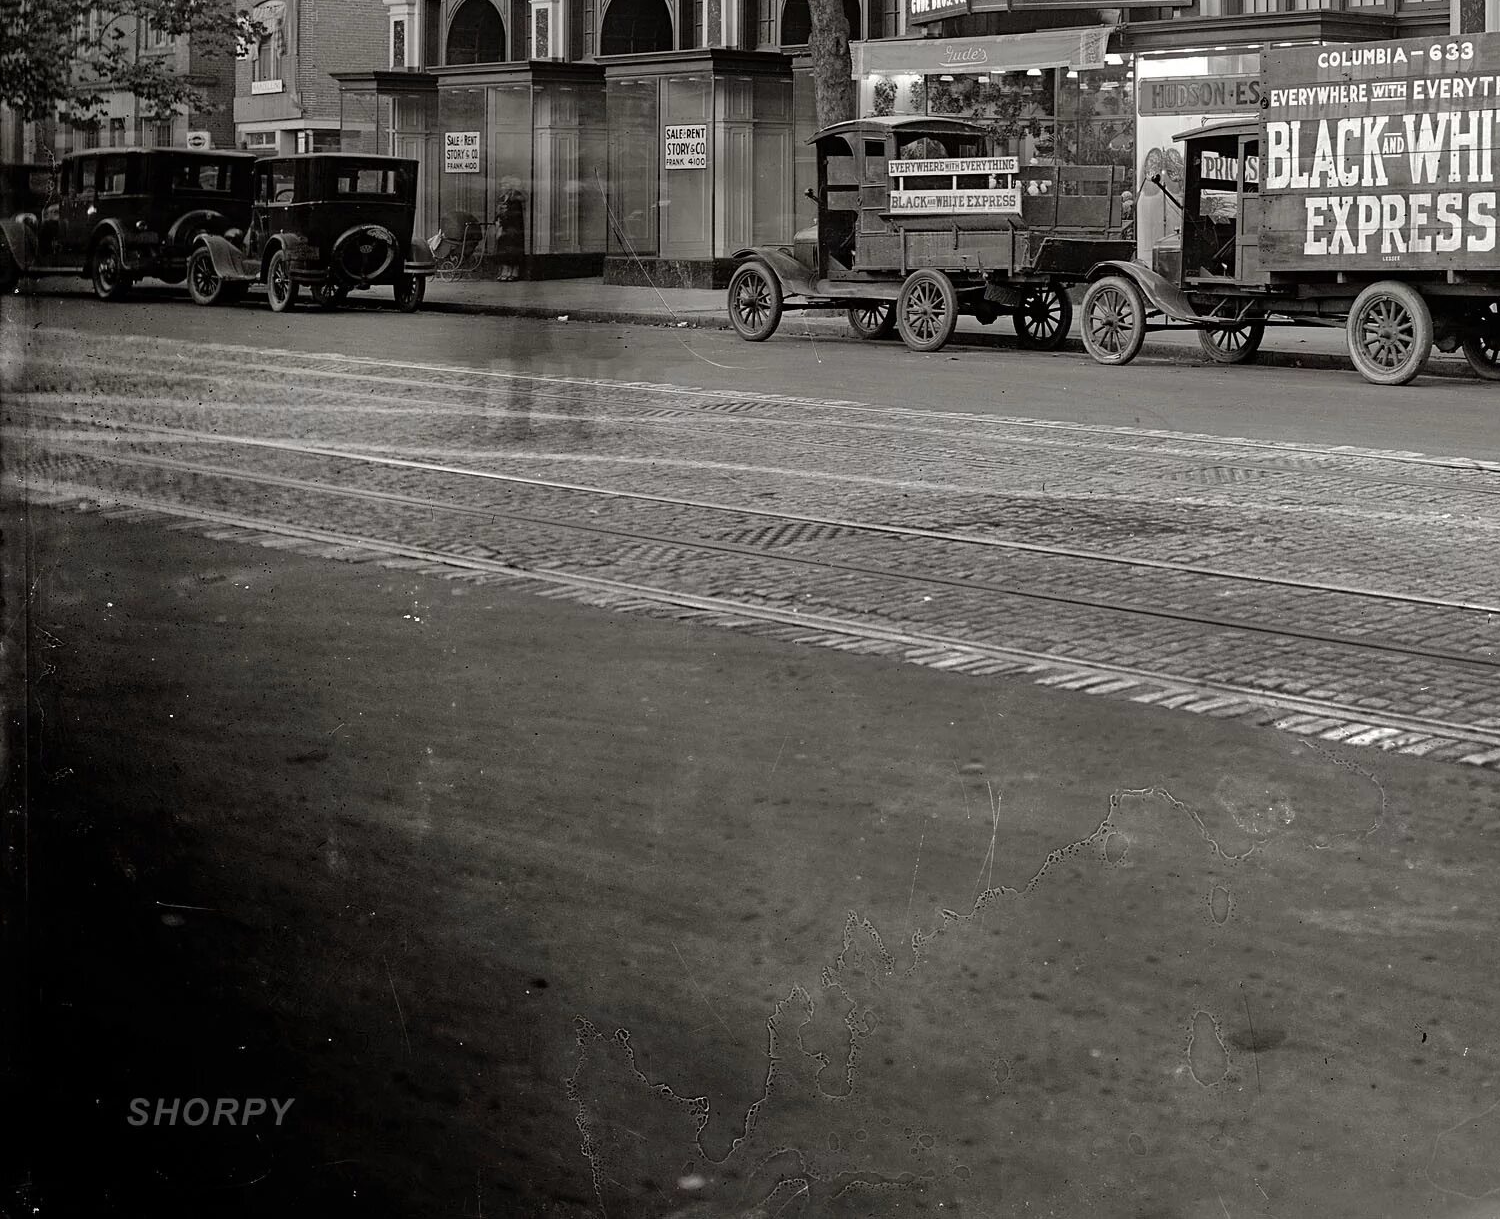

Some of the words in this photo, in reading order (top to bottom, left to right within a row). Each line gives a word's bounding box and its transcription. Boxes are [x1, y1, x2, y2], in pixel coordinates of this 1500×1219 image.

[945, 45, 986, 63] Gude's
[1318, 47, 1408, 68] COLUMBIA
[1429, 42, 1474, 61] 633
[1151, 82, 1225, 109] HUDSON
[1270, 84, 1368, 107] EVERYWHERE
[1372, 82, 1407, 101] WITH
[447, 135, 460, 146] SALE
[464, 135, 477, 146] RENT
[666, 128, 683, 140] SALE
[687, 128, 706, 139] RENT
[446, 149, 465, 160] STORY
[667, 142, 690, 156] STORY
[1266, 116, 1389, 190] BLACK
[1382, 134, 1405, 156] AND
[688, 158, 705, 166] 4100
[890, 161, 945, 173] EVERYWHERE
[945, 163, 960, 171] WITH
[960, 158, 1015, 172] EVERYTHING
[1203, 155, 1258, 181] PRICS
[891, 196, 928, 210] BLACK
[935, 195, 965, 209] WHITE
[966, 195, 1016, 208] EXPRESS
[1303, 192, 1497, 256] EXPRESS
